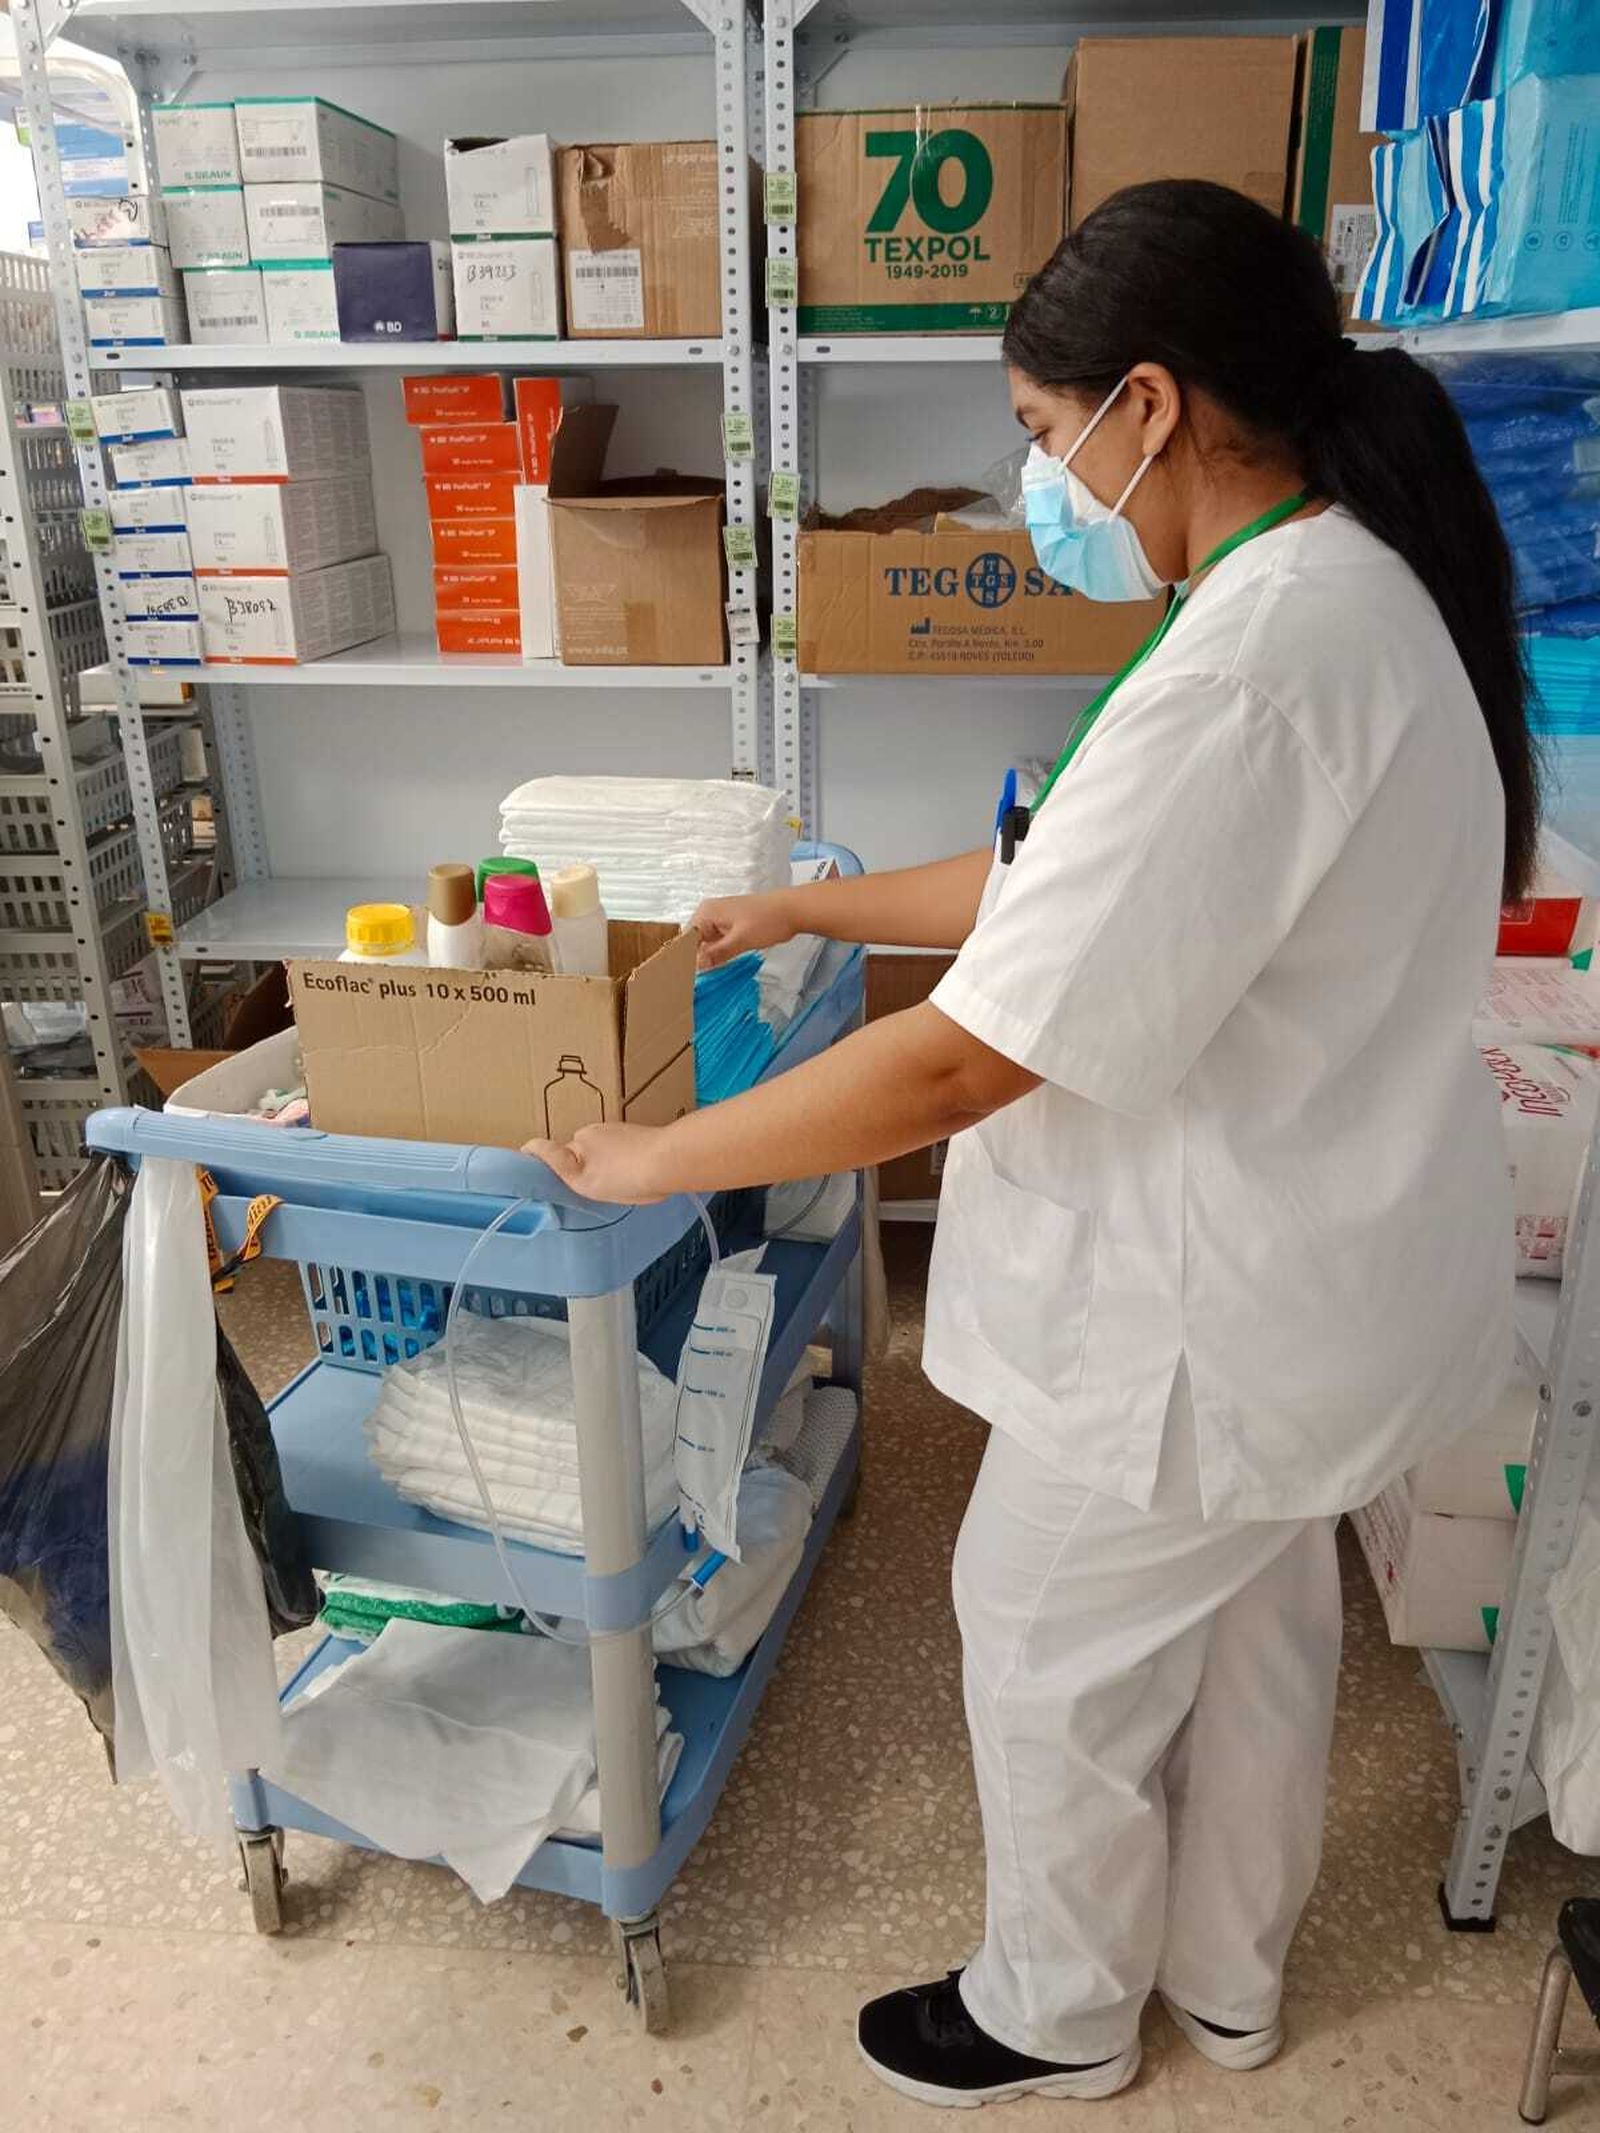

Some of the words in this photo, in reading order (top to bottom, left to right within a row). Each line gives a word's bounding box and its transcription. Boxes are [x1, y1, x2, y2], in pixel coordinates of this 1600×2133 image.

[865, 128, 993, 234] 70
[863, 236, 991, 262] TEXPOL
[886, 264, 969, 279] 1949-2019
[386, 321, 402, 332] BD
[884, 567, 959, 597] TEG
[379, 981, 416, 999] plus
[426, 983, 449, 1000] 10
[454, 988, 464, 1000] x
[470, 985, 509, 1003] 500
[513, 988, 536, 1005] ml
